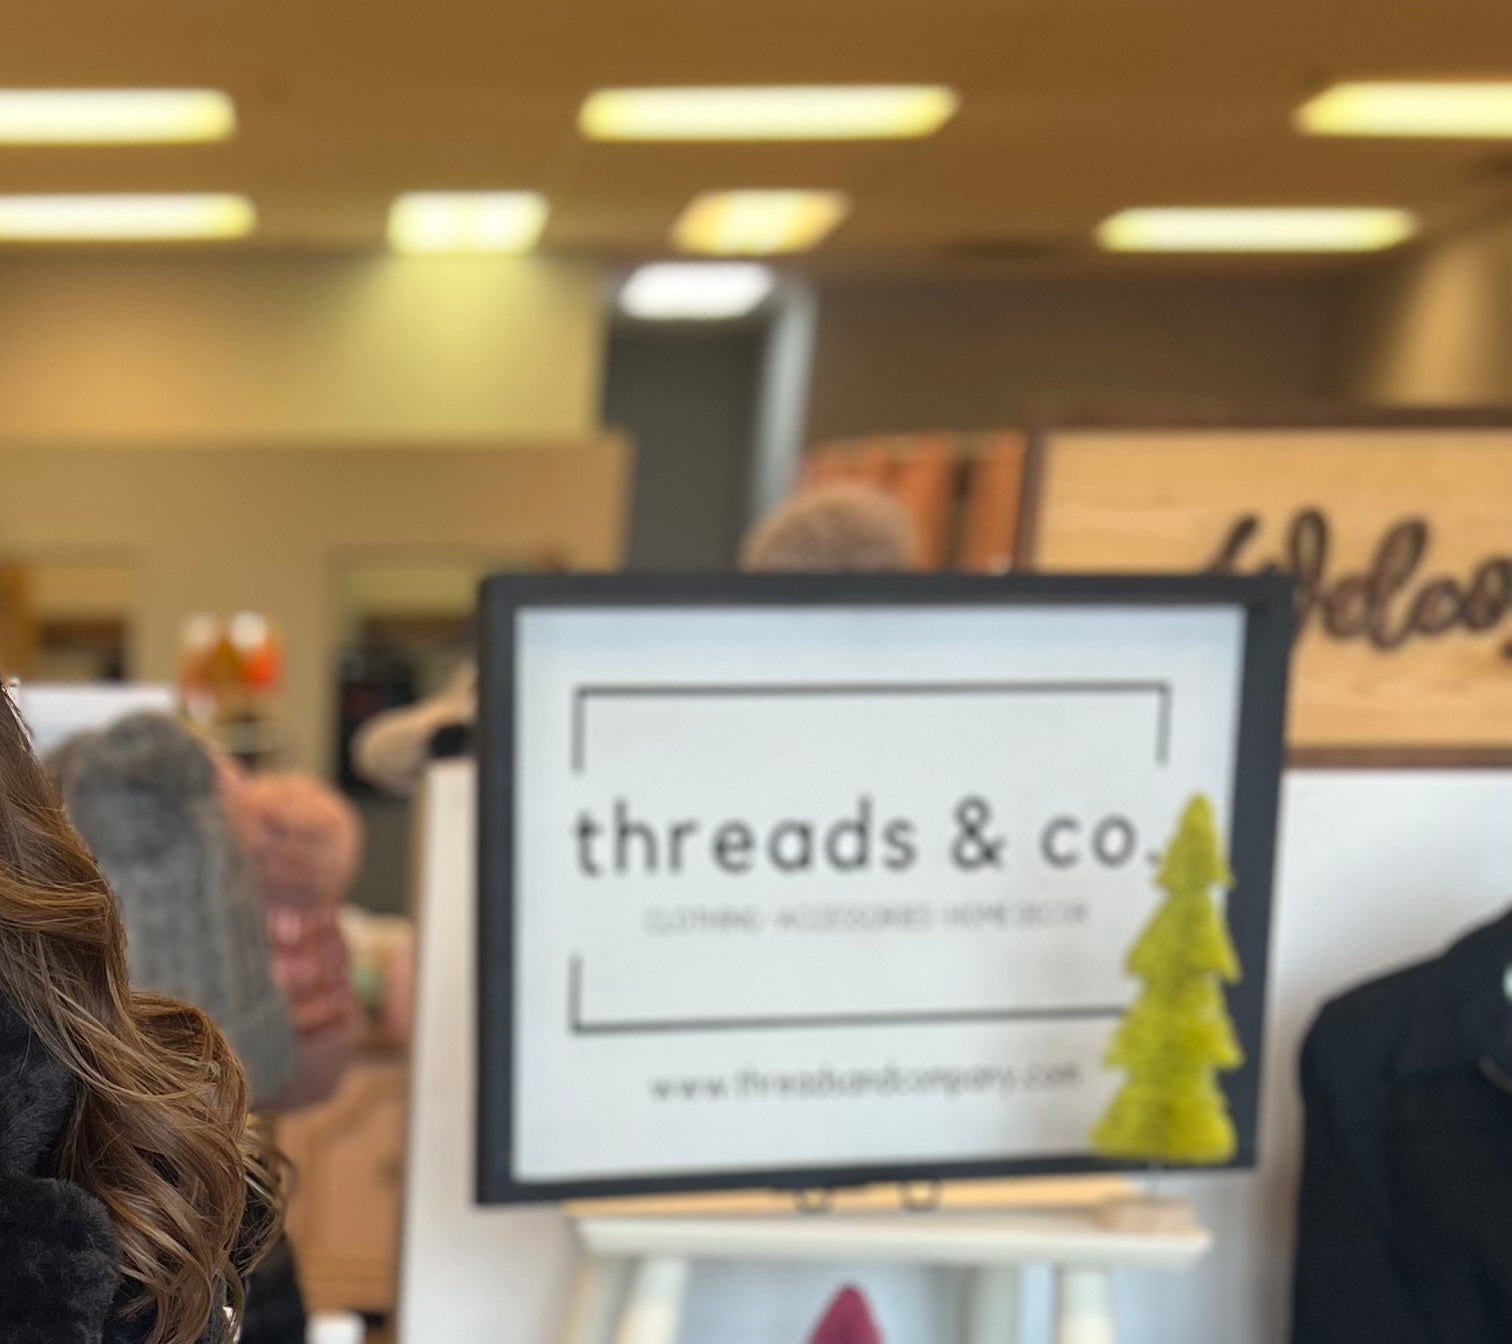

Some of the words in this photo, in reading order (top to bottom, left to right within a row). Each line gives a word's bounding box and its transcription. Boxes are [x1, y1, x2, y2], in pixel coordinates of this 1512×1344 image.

[574, 795, 917, 877] threads
[948, 794, 1006, 872] &
[1039, 813, 1161, 870] co.
